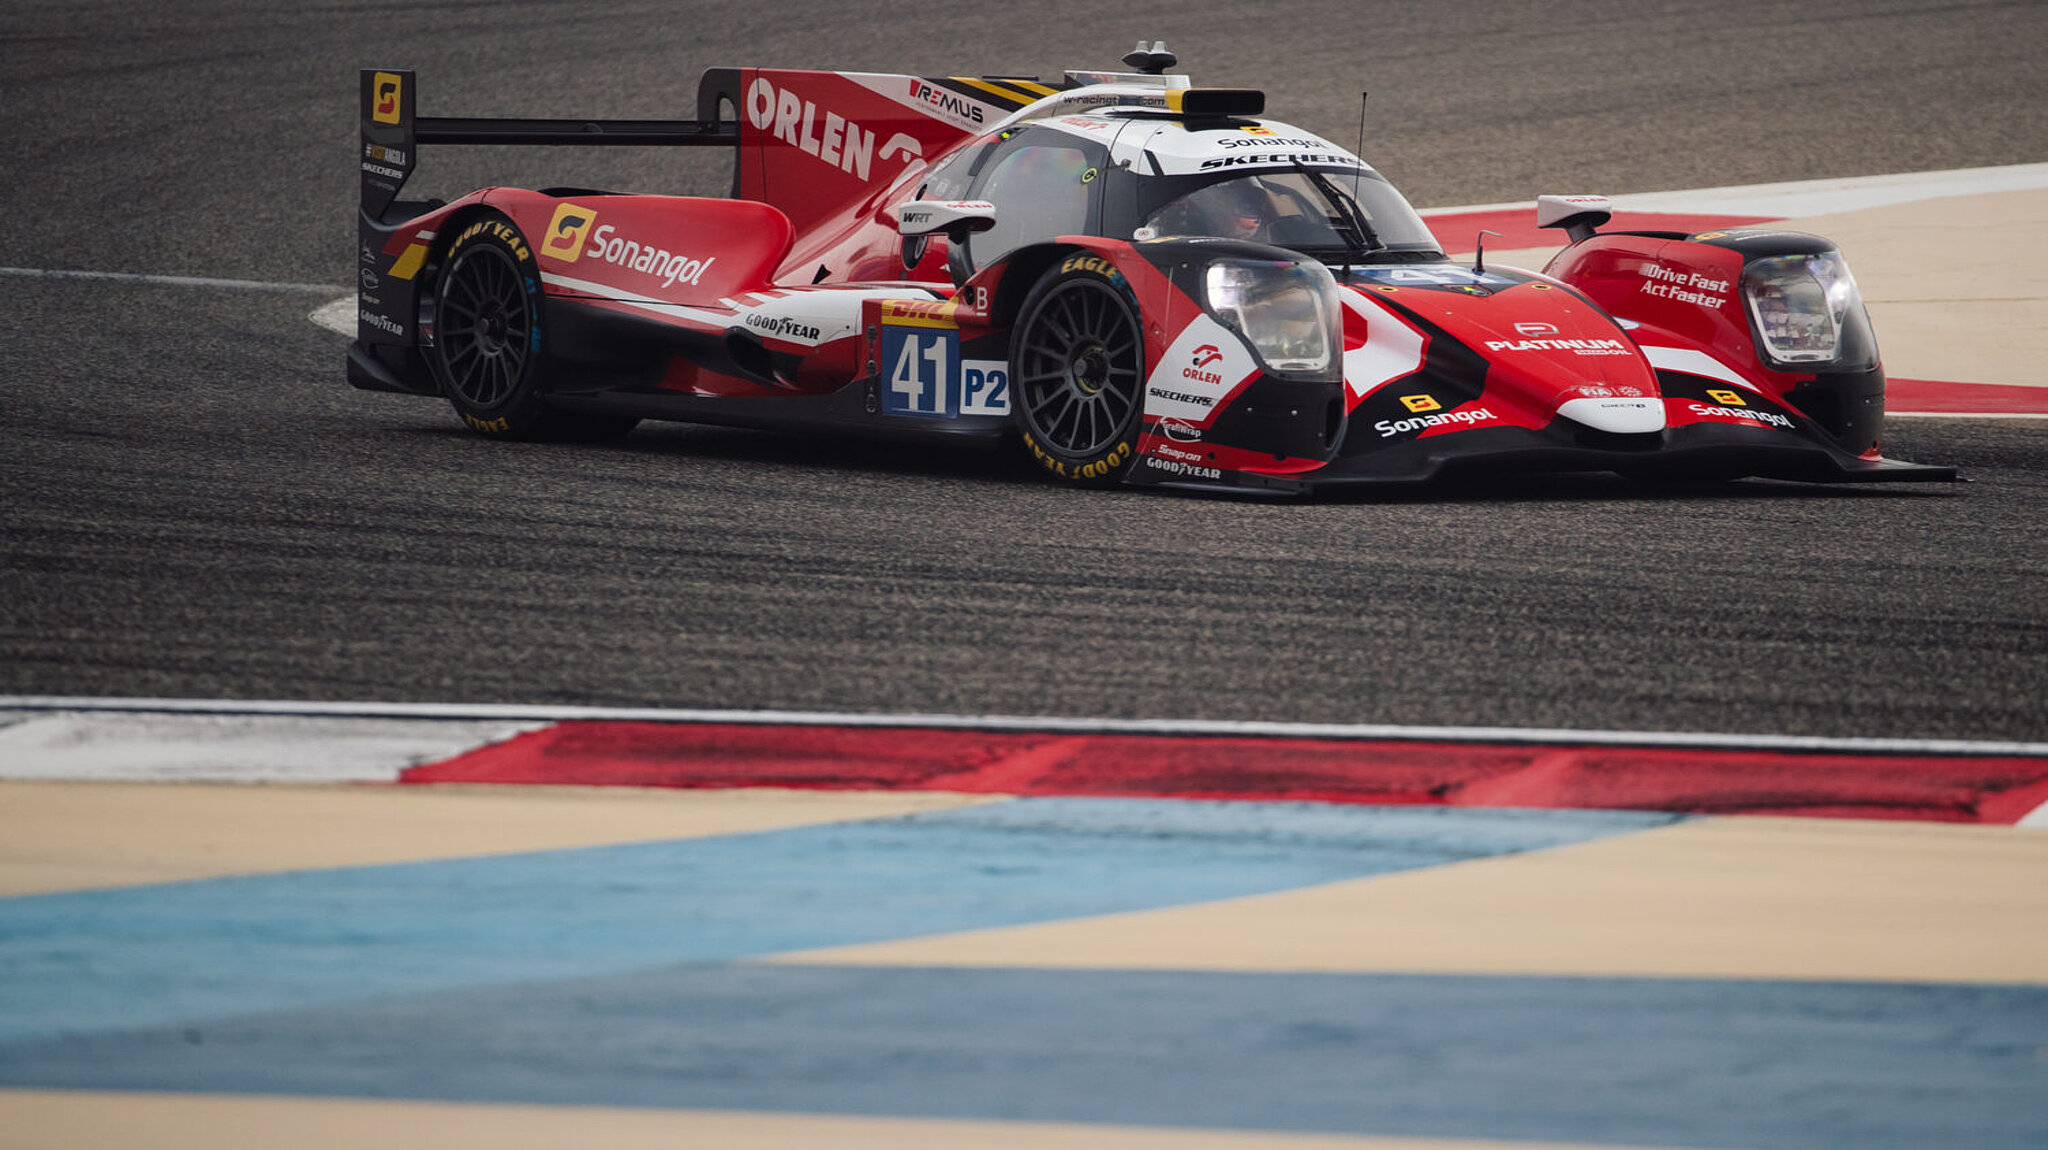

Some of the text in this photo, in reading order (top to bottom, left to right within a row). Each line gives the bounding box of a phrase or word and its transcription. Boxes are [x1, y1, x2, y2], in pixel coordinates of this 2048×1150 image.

[917, 84, 984, 124] REMUS
[1063, 94, 1165, 107] w-racingtcom
[747, 77, 875, 183] ORLEN
[1218, 137, 1330, 151] Sonangol
[1200, 153, 1365, 171] SKECHERS
[903, 212, 933, 223] WRT
[448, 219, 531, 263] GOODYEAR
[586, 224, 717, 289] Sonangol
[1061, 256, 1118, 279] EAGLE
[1647, 262, 1730, 293] Drive Fast
[1640, 279, 1727, 309] Act Faster
[360, 309, 404, 336] GOODYEAR
[745, 313, 820, 340] GOODYEAR
[1484, 339, 1625, 351] PLATINUM
[891, 334, 947, 414] 41
[1182, 367, 1222, 385] ORLEN
[964, 368, 1007, 408] P2
[1149, 387, 1214, 408] SKECHERS
[1374, 408, 1498, 438] Sonangol
[1688, 404, 1796, 429] Sonangol
[1146, 457, 1221, 480] GOODYEAR
